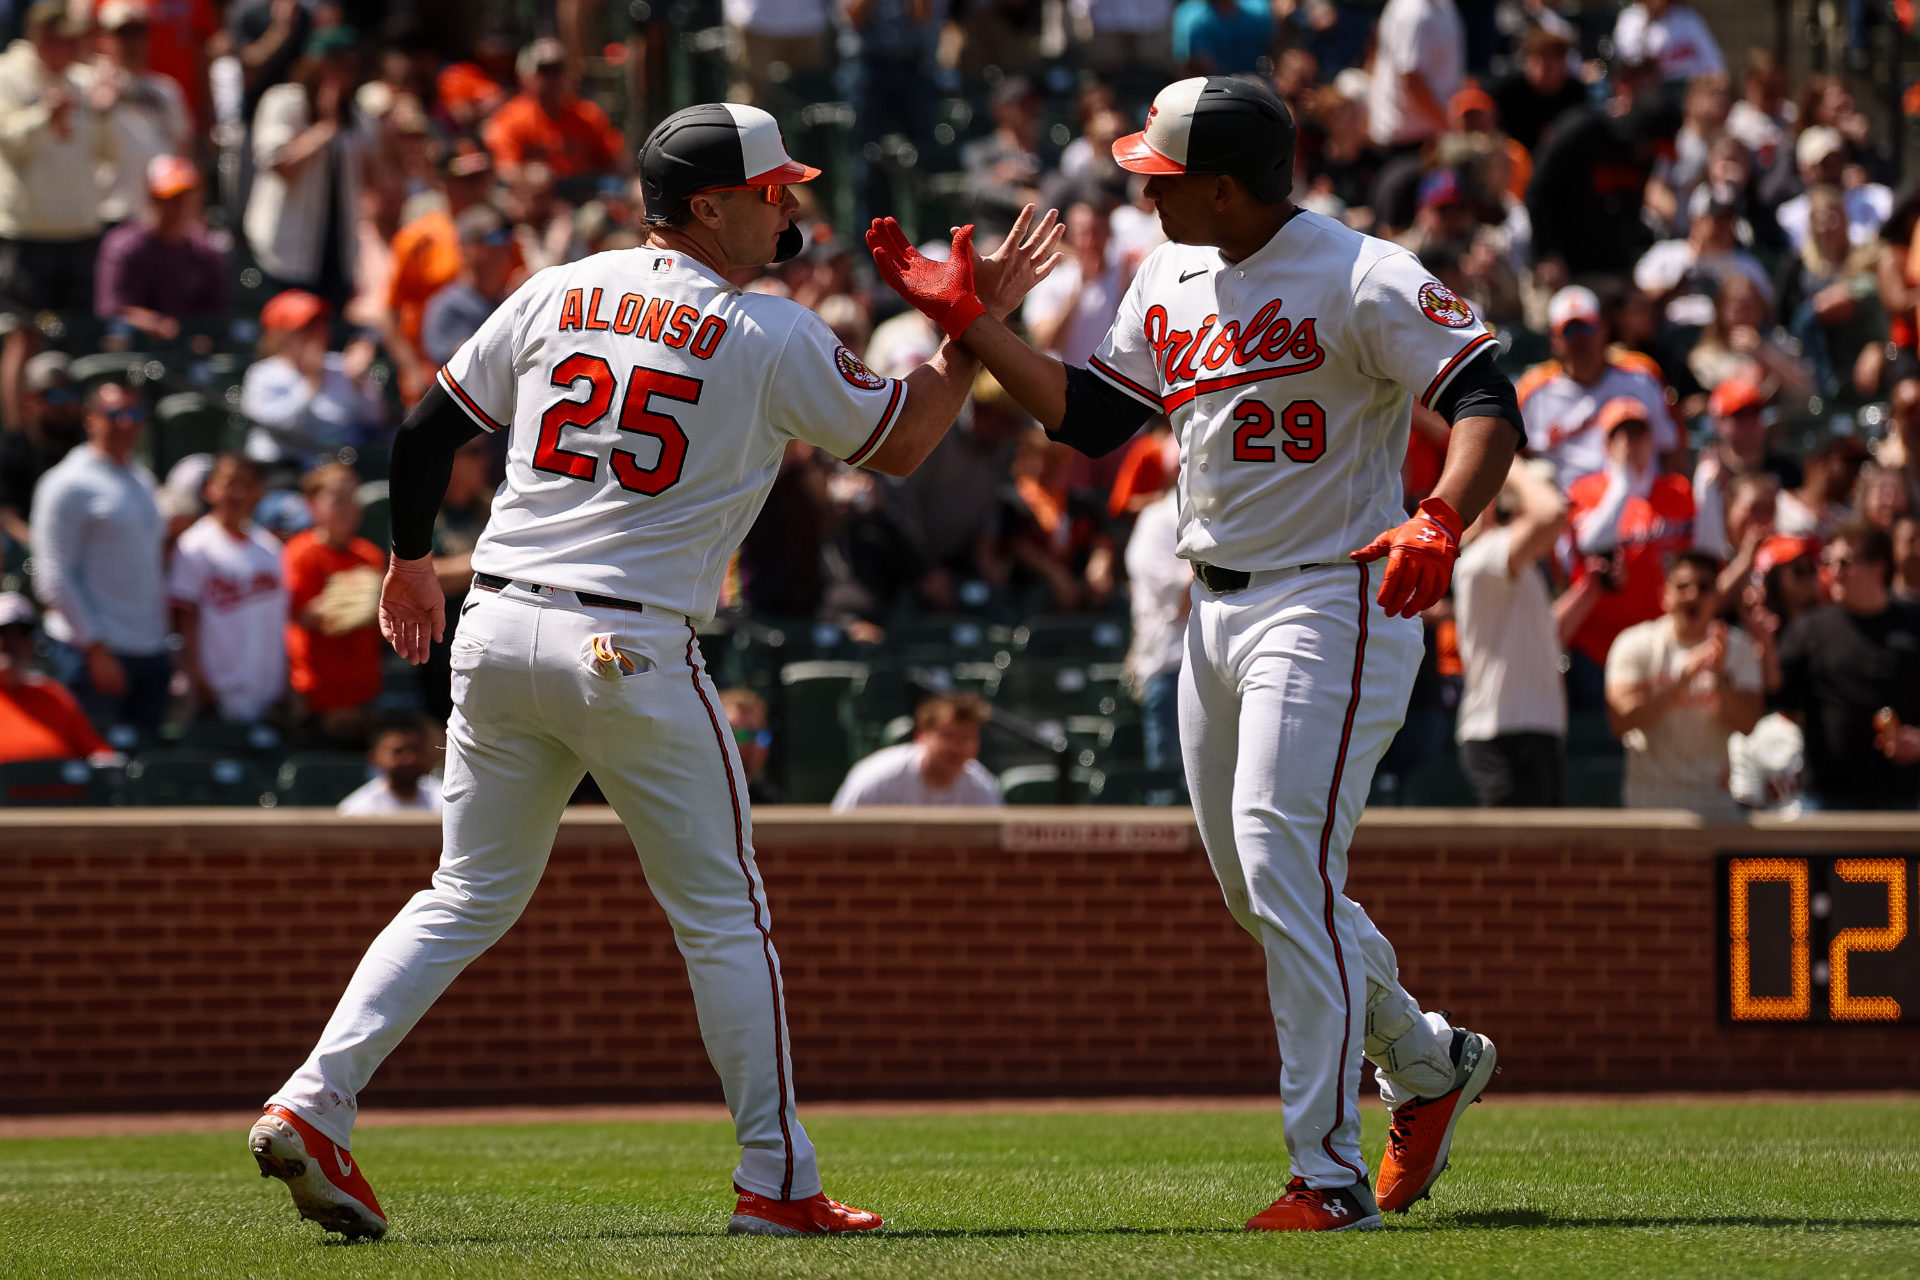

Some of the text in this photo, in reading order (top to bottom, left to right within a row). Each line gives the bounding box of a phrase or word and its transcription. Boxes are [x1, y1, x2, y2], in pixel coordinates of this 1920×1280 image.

[559, 287, 728, 361] ALONSO
[1143, 298, 1325, 388] Orioles
[531, 351, 704, 498] 25
[1233, 399, 1327, 463] 29
